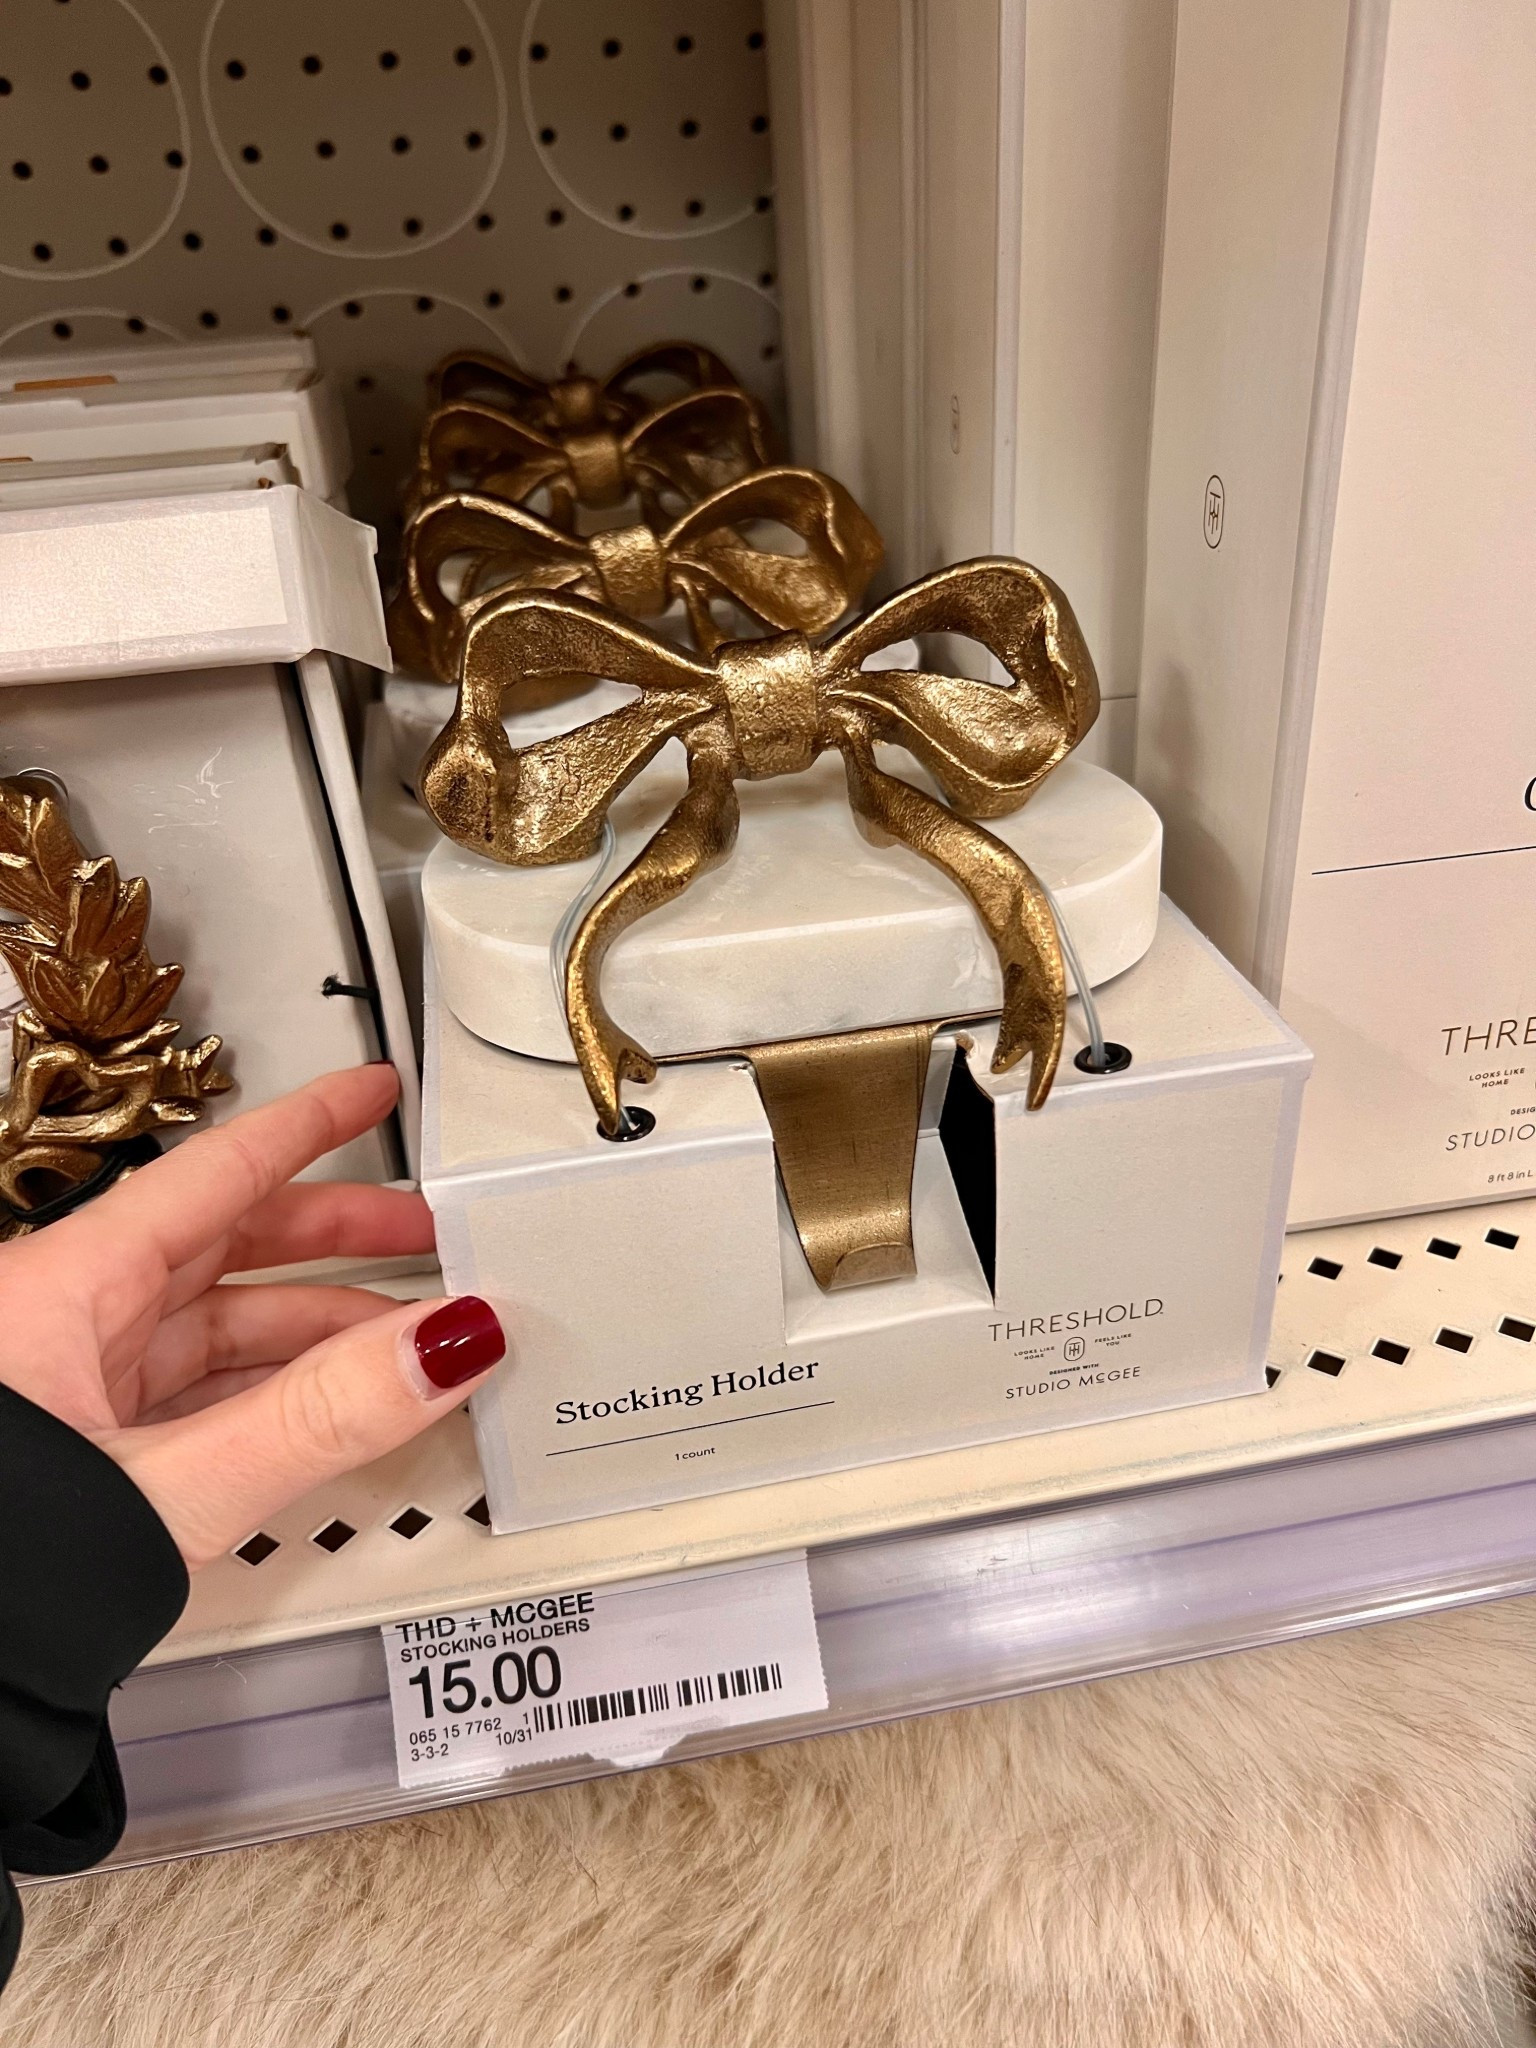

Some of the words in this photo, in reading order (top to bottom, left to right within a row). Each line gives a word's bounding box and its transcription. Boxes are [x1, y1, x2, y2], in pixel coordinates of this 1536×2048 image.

[1469, 1071, 1501, 1081] LOOKS
[1504, 1068, 1525, 1076] LIKE
[1481, 1079, 1509, 1088] HOME
[1446, 1123, 1536, 1151] STUDIO
[1488, 1175, 1494, 1183] 8
[1497, 1173, 1505, 1182] ft
[1507, 1172, 1514, 1180] 8
[1516, 1171, 1525, 1179] in
[988, 1298, 1163, 1342] THRESHOLD
[1049, 1366, 1081, 1375] DESIGNED
[556, 1384, 704, 1424] Stocking
[711, 1361, 819, 1396] Holder
[1006, 1379, 1071, 1399] STUDIO
[682, 1447, 716, 1459] count
[395, 1616, 456, 1644] THD
[465, 1617, 482, 1632] +
[490, 1592, 596, 1629] MCGEE
[400, 1634, 498, 1664] STOCKING
[503, 1617, 591, 1646] HOLDERS
[408, 1645, 562, 1719] 15.00
[409, 1728, 437, 1746] 065
[444, 1724, 460, 1740] 15
[466, 1717, 502, 1736] 7762
[496, 1728, 533, 1747] 10/31
[411, 1743, 449, 1762] 3-3-2
